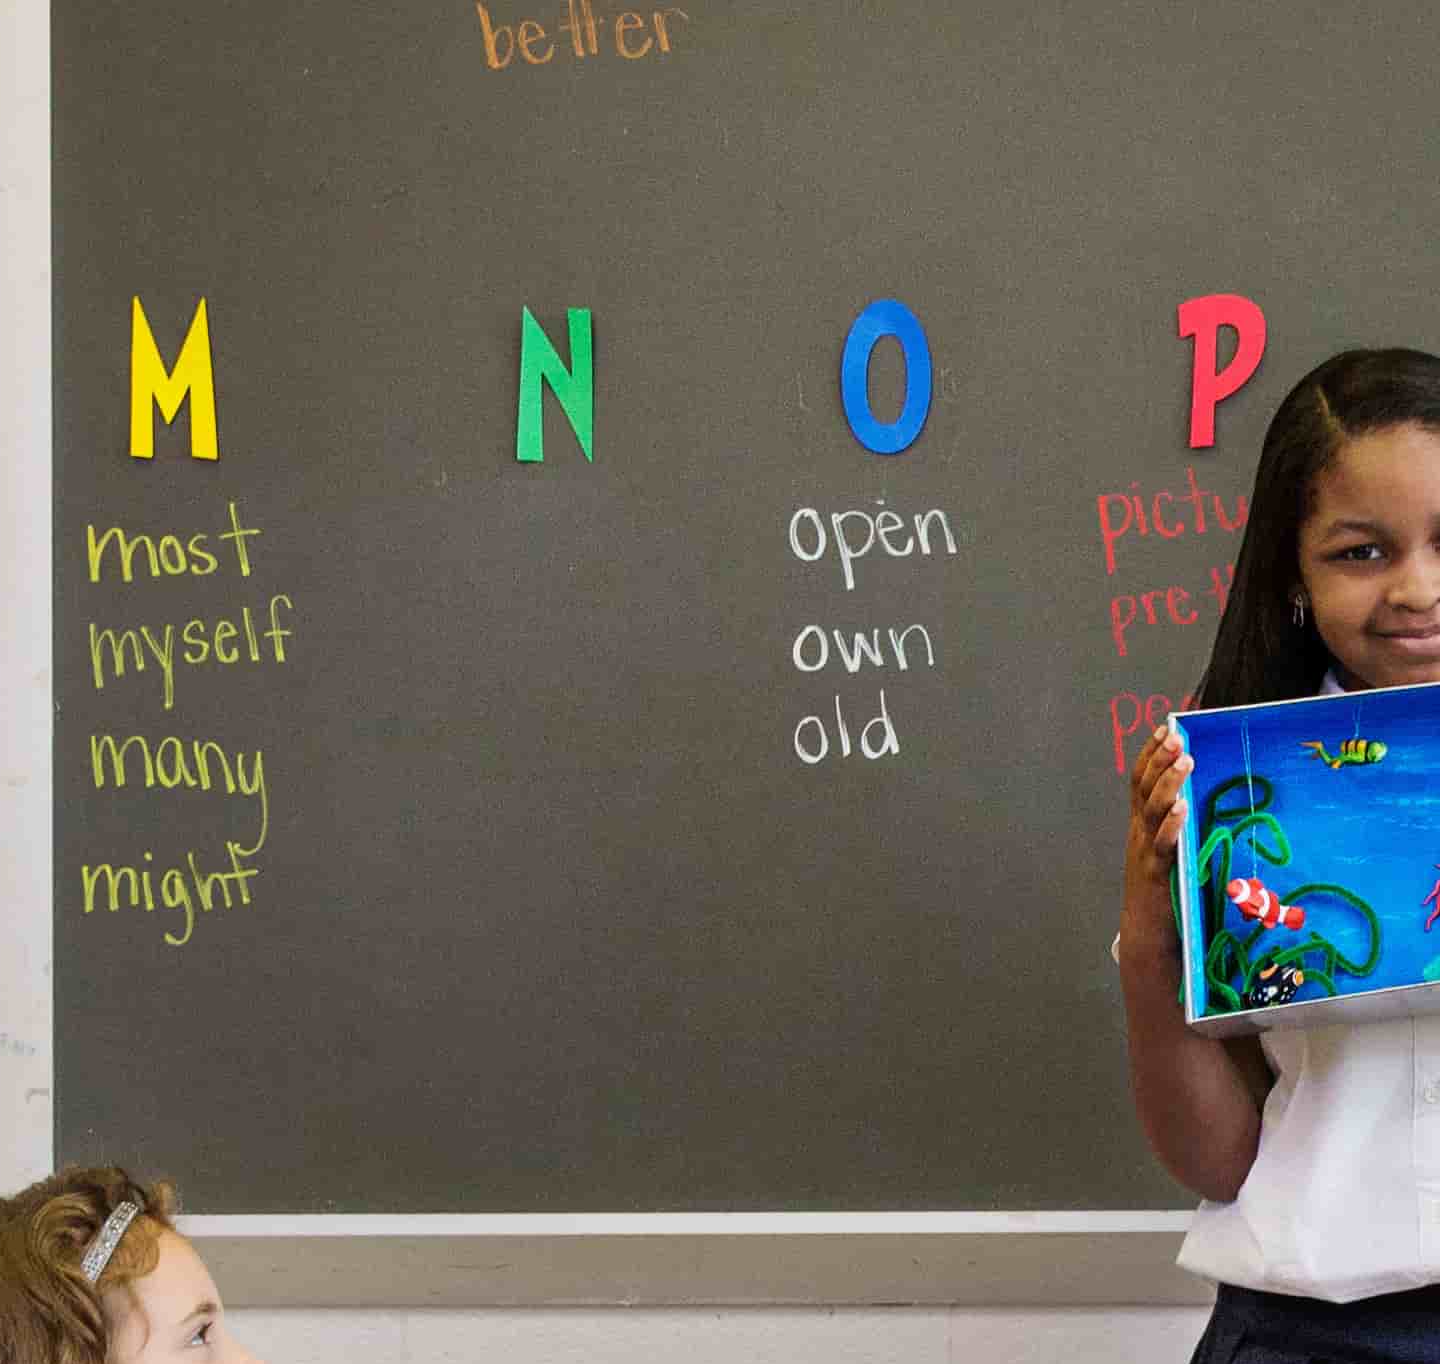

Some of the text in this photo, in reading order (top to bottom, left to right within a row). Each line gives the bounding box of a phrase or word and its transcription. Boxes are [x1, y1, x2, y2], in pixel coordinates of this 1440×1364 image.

[130, 296, 219, 460] M
[517, 305, 594, 463] N
[841, 299, 932, 455] O
[1177, 293, 1268, 448] P
[86, 501, 262, 583] most
[788, 505, 957, 591] open
[88, 595, 293, 710] myself
[792, 624, 935, 673] own
[794, 689, 900, 764] old
[89, 734, 269, 857] many
[82, 841, 259, 944] might
